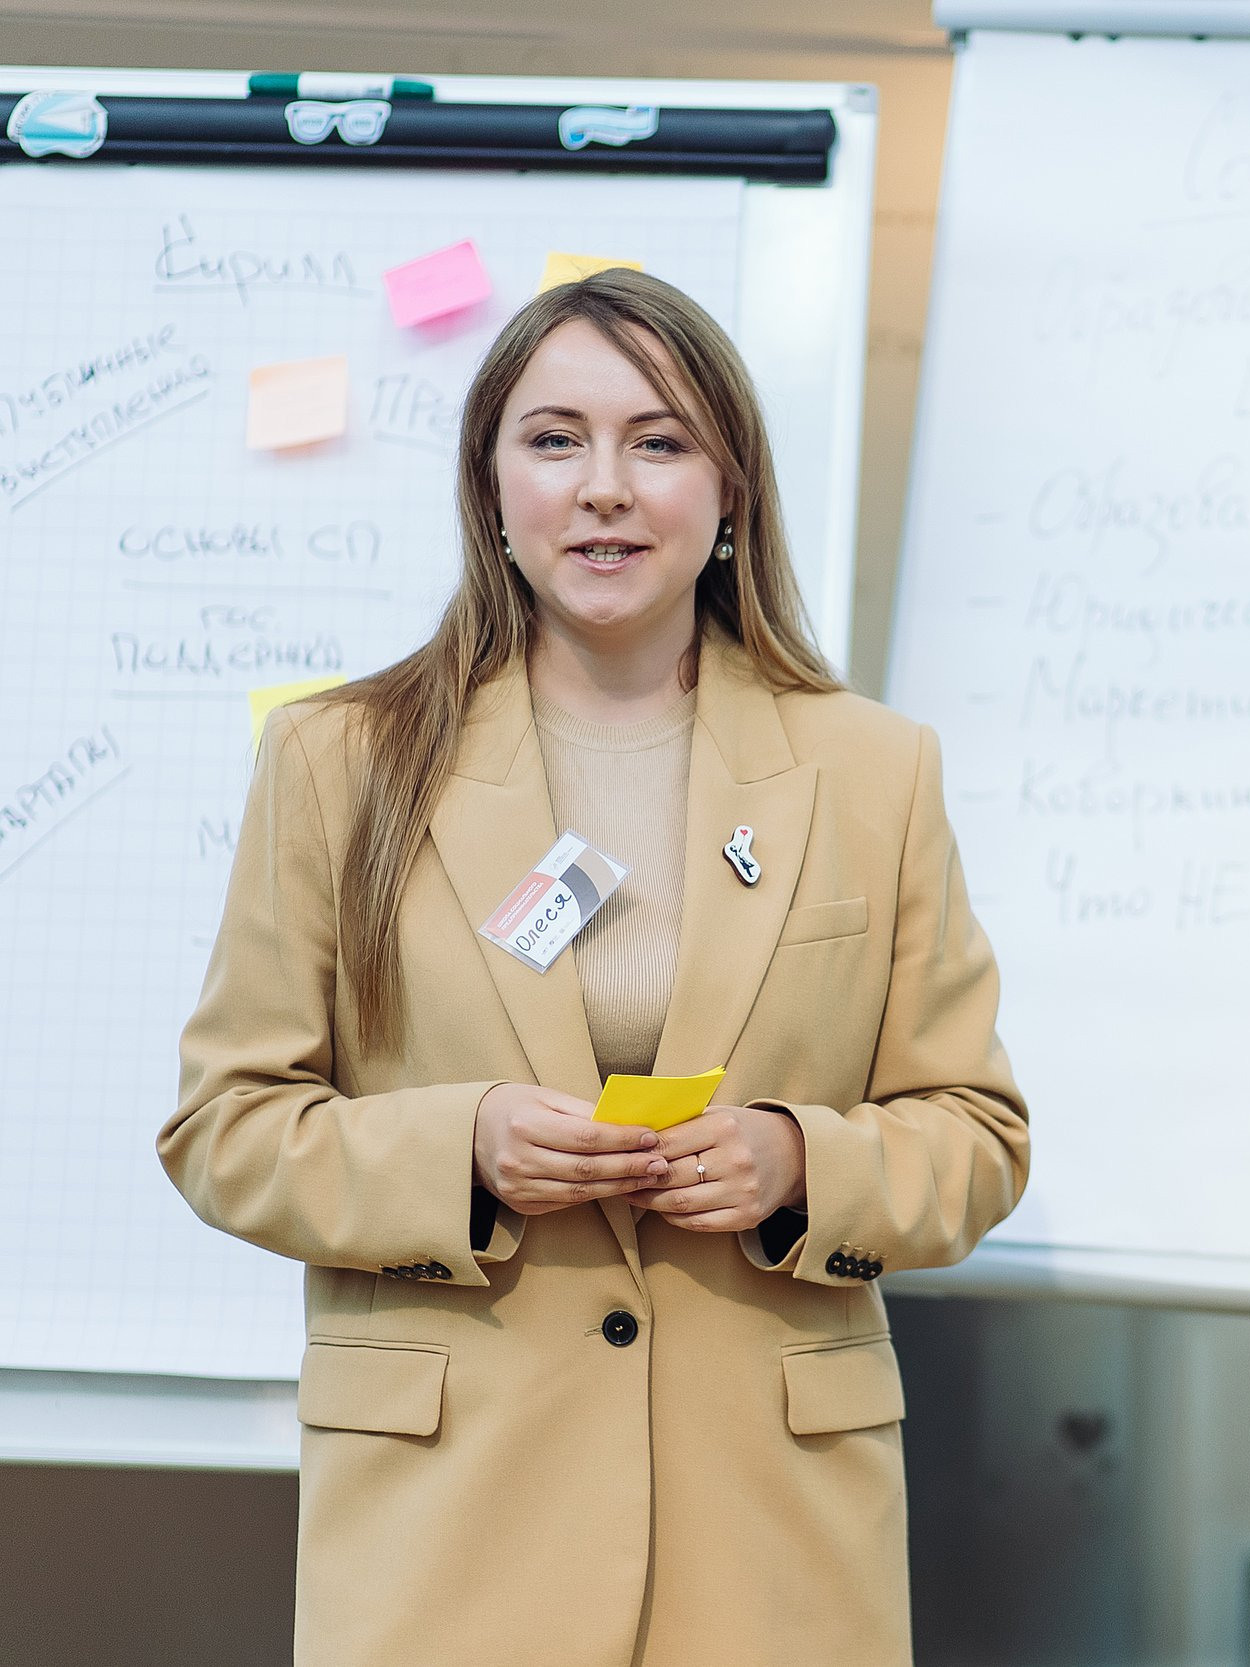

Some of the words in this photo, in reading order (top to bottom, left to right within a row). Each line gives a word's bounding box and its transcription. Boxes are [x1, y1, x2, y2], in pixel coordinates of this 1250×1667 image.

[154, 214, 357, 307] Кирилл
[118, 523, 284, 561] ОСНОВЫ
[307, 519, 383, 564] СП
[1045, 847, 1154, 926] Что
[515, 893, 572, 951] Олеся
